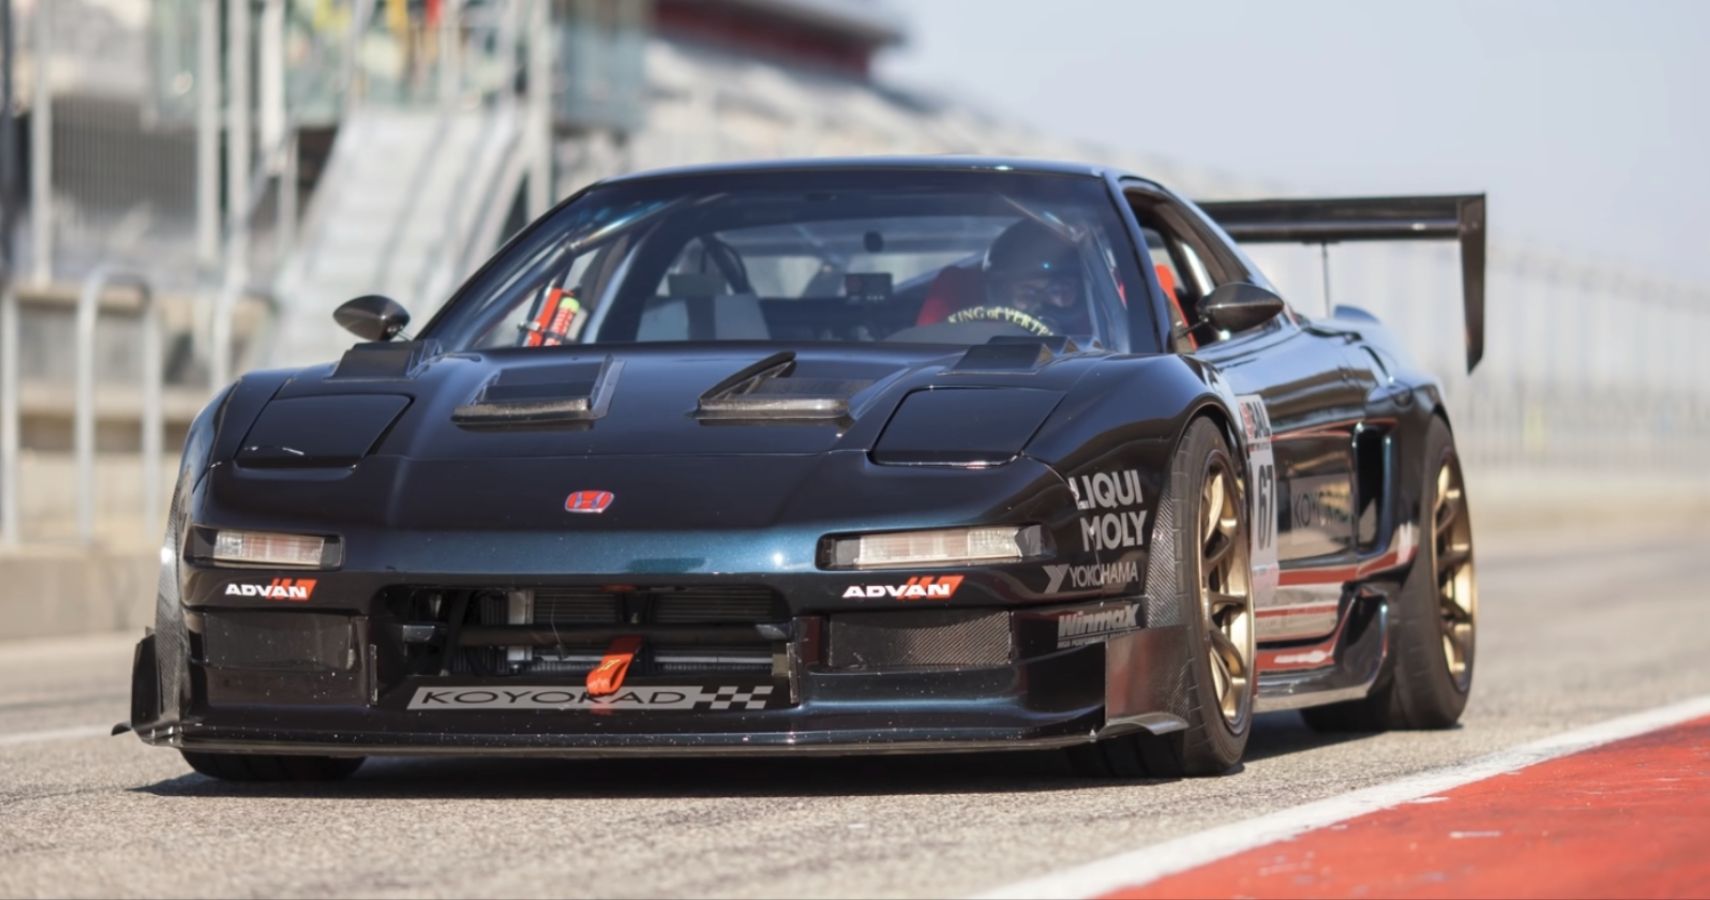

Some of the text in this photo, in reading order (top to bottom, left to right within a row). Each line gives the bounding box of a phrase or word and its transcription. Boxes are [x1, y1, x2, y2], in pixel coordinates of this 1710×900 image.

[948, 305, 985, 324] KING
[1067, 469, 1144, 511] LIQUI
[1258, 464, 1274, 551] 67
[1079, 510, 1148, 553] MOLY
[1069, 561, 1139, 588] YOKOHAMA
[224, 583, 308, 600] ADVAN
[842, 583, 951, 599] ADVAN
